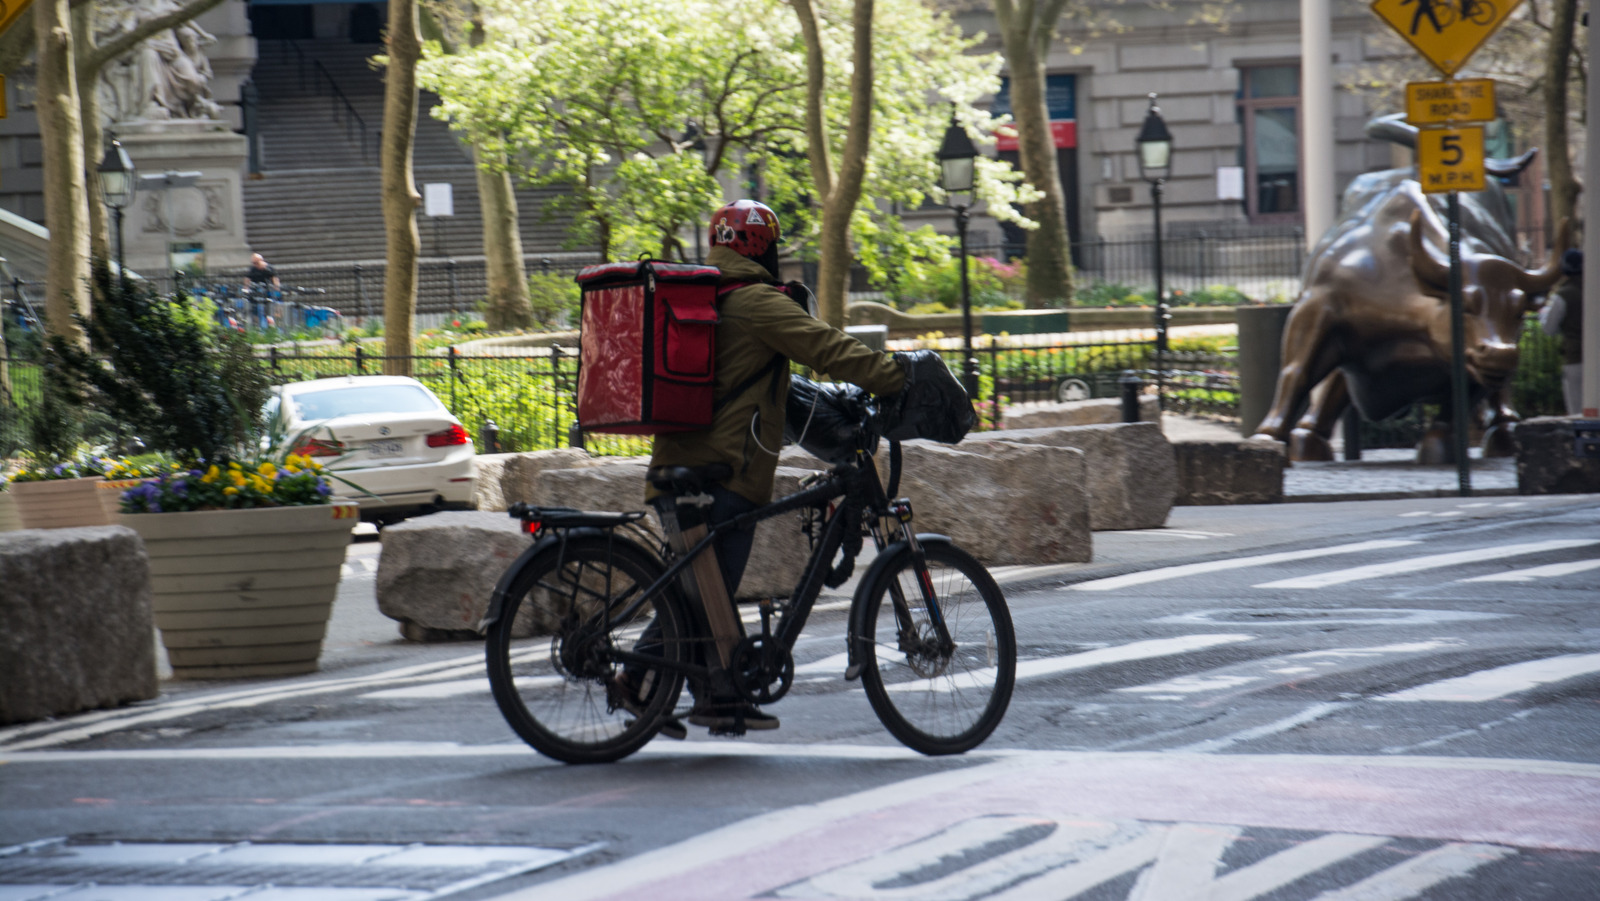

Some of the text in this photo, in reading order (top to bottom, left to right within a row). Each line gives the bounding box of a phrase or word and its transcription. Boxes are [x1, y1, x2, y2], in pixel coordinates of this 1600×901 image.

[1416, 85, 1484, 101] SHARE THE
[1430, 102, 1471, 116] ROAD
[1440, 136, 1464, 166] 5
